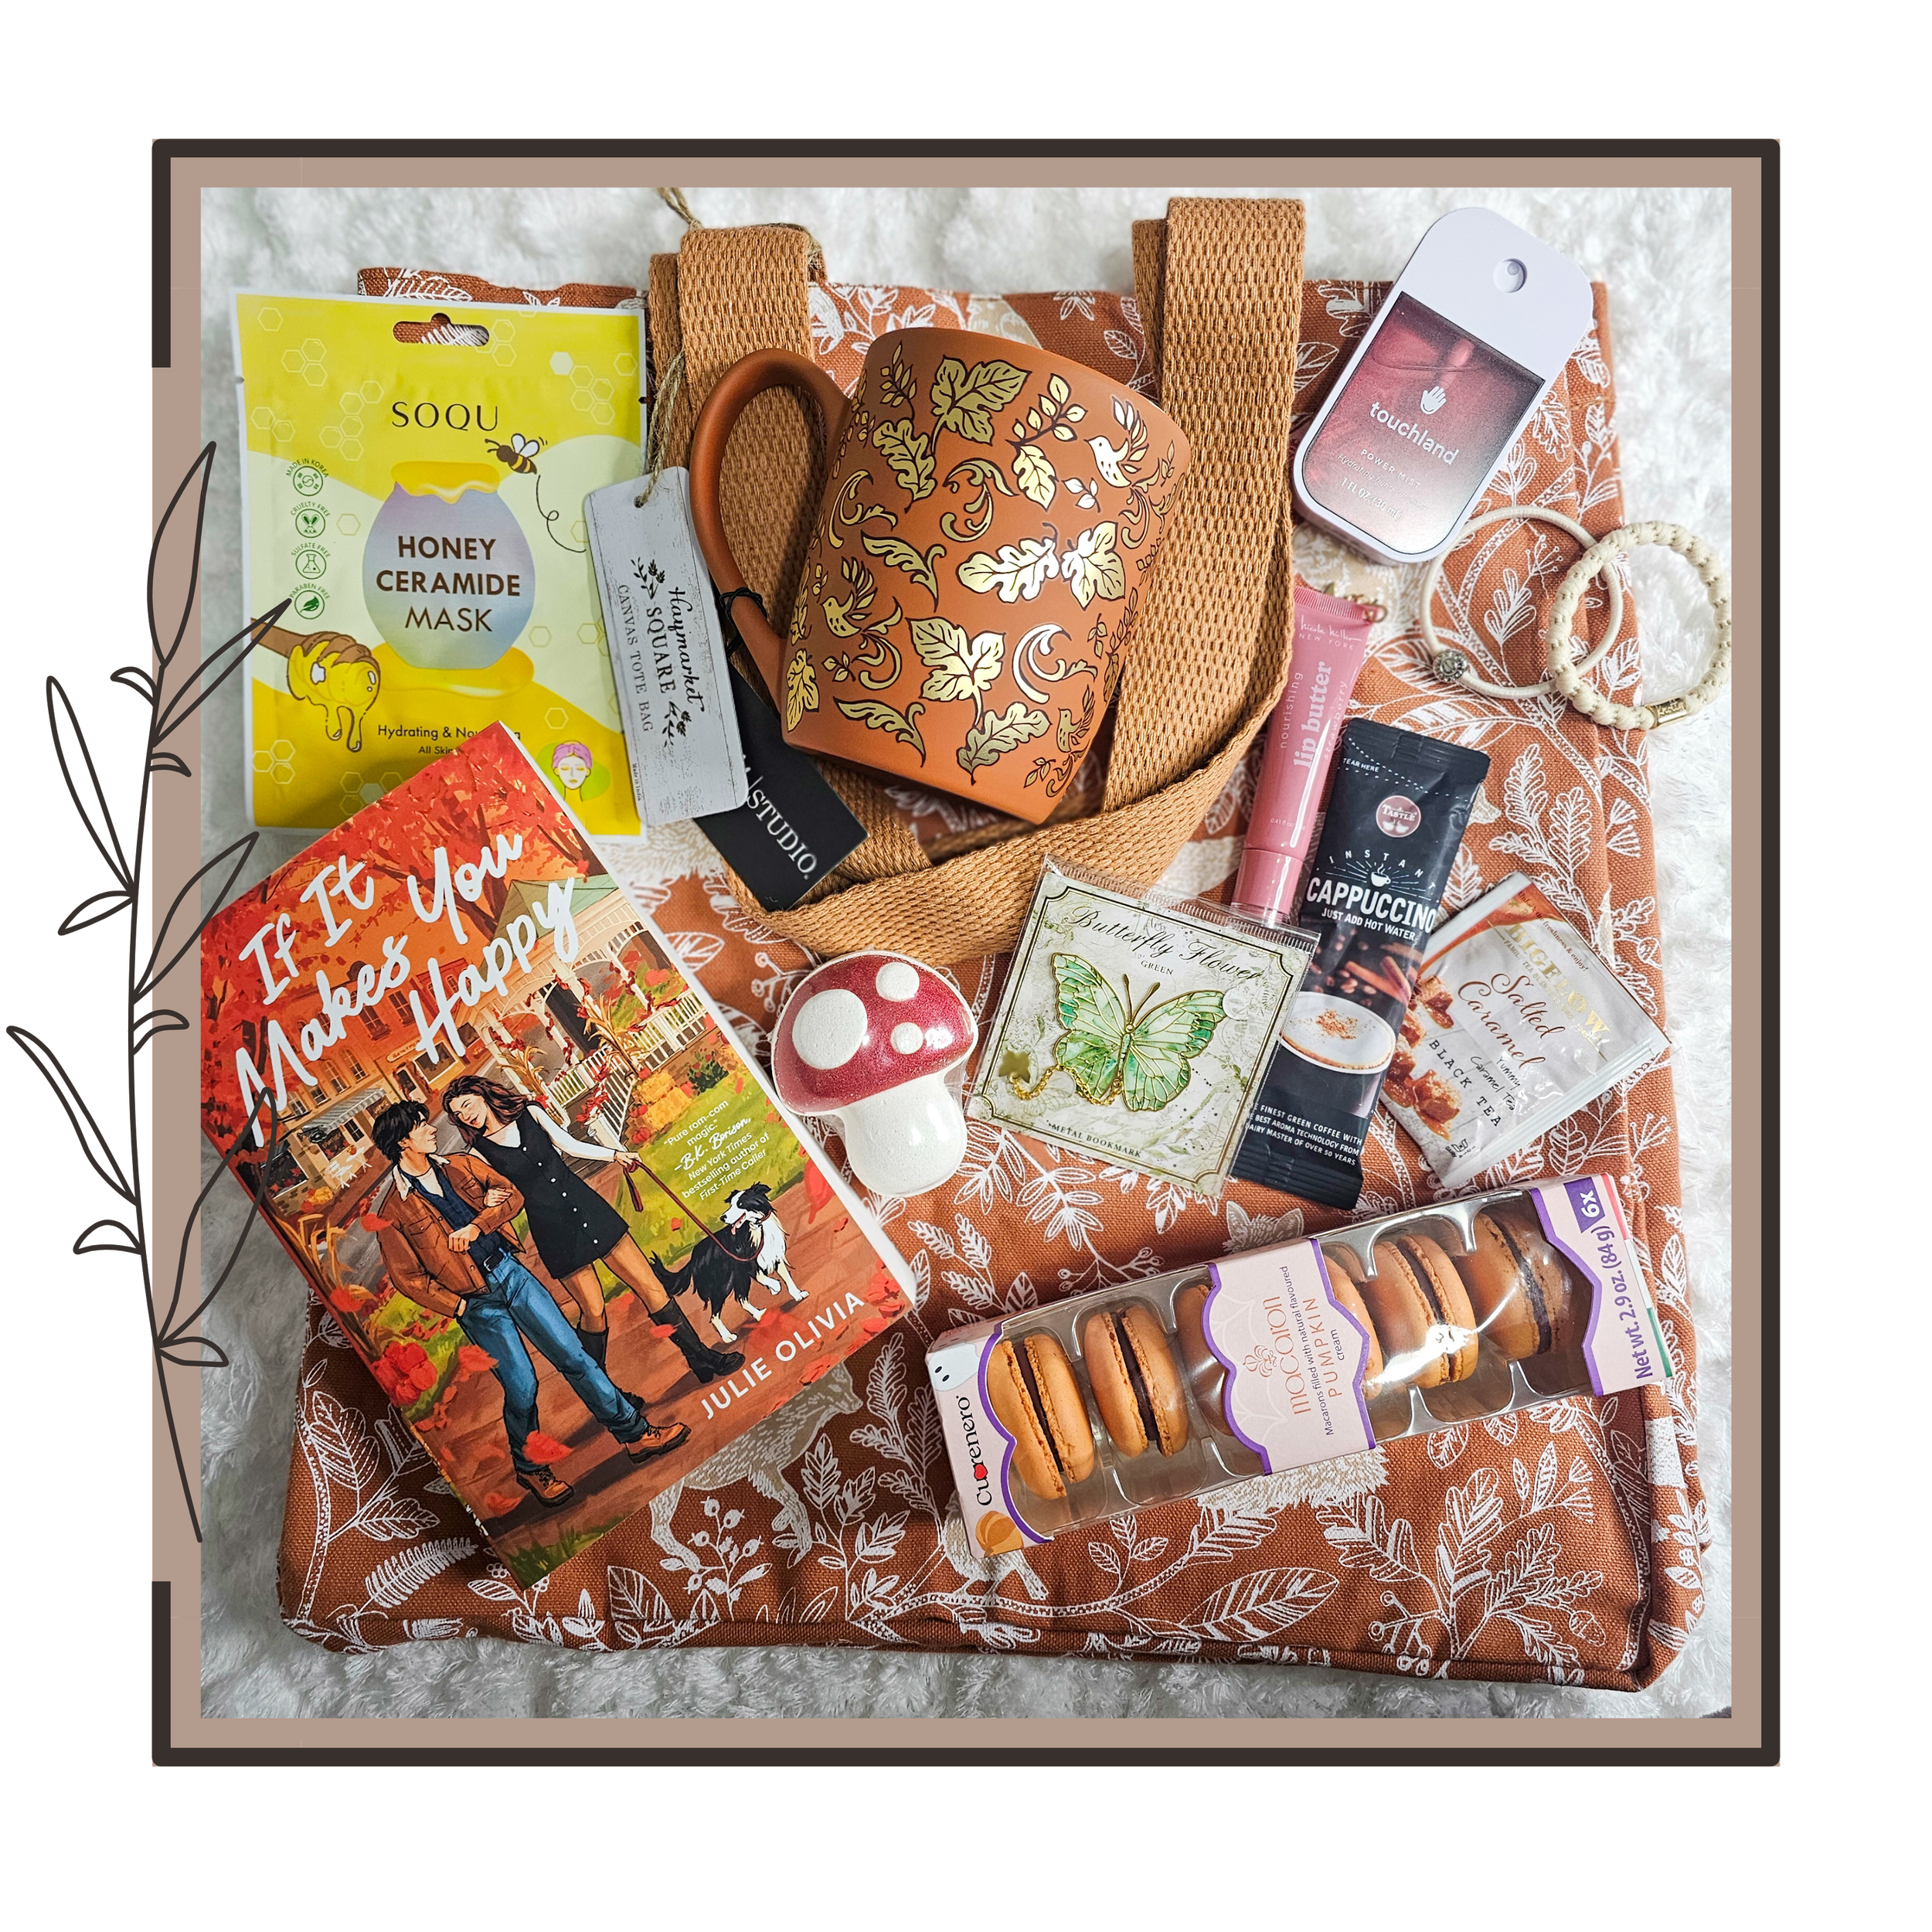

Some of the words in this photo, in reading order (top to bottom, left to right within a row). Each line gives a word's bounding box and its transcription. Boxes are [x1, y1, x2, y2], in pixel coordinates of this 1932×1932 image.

[392, 401, 498, 431] SOQU
[1369, 402, 1459, 464] touchland
[286, 459, 301, 477] MADE
[311, 458, 329, 478] KOREA
[1337, 454, 1375, 481] Hydrating
[1361, 448, 1395, 474] POWER
[1397, 471, 1421, 489] MIST
[290, 502, 316, 515] CRUELTY
[317, 503, 331, 518] FREE
[1341, 478, 1347, 487] 1
[1347, 481, 1358, 493] FL
[1371, 496, 1388, 511] (30
[291, 543, 316, 556] SULFATE
[317, 544, 332, 558] FREE
[397, 536, 496, 560] HONEY
[289, 583, 317, 598] PARABEN
[317, 586, 331, 600] FREE
[376, 570, 521, 597] CERAMIDE
[404, 605, 493, 632] MASK
[618, 584, 638, 646] CANVAS
[631, 651, 647, 694] TOTE
[639, 701, 654, 732] BAG
[647, 607, 676, 694] SQUARE
[668, 587, 705, 713] Haymarket
[1299, 633, 1321, 642] NEW
[1328, 638, 1353, 650] YORK
[1281, 672, 1304, 749] nourishing
[1301, 661, 1332, 733] butter
[378, 724, 438, 741] Hydrating
[443, 726, 452, 738] &
[1323, 681, 1348, 760] strawberry
[418, 746, 431, 754] All
[1293, 737, 1318, 769] lip
[1342, 758, 1360, 767] TEAR
[1360, 763, 1380, 773] HERE
[1328, 849, 1436, 889] INSTANT
[1306, 877, 1437, 934] CAPPUCCINO
[239, 913, 300, 1005] If
[301, 855, 376, 947] It
[1321, 908, 1344, 920] JUST
[1345, 913, 1363, 926] ADD
[1364, 918, 1383, 931] HOT
[1384, 923, 1416, 941] WATER
[1060, 906, 1175, 957] Butterfly
[1179, 940, 1265, 980] Flower
[408, 876, 579, 1065] Happy
[1141, 960, 1175, 976] GREEN
[1505, 923, 1610, 1033] BIGELOW
[1522, 960, 1534, 974] TEA
[234, 934, 411, 1148] Makes
[406, 833, 523, 945] You
[1491, 973, 1566, 1039] Salted
[1458, 981, 1546, 1070] Caramel
[1428, 1039, 1472, 1088] BLACK
[1476, 1096, 1502, 1127] TEA
[1470, 1056, 1505, 1093] Caramel
[1502, 1092, 1515, 1111] Tea
[1496, 1056, 1521, 1091] Yummy
[688, 1100, 729, 1131] rom-com
[1260, 1104, 1286, 1118] FINEST
[1287, 1114, 1312, 1129] GREEN
[1313, 1124, 1342, 1139] COFFEE
[1342, 1133, 1363, 1146] WITH
[708, 1117, 752, 1151] Borison,
[1051, 1124, 1083, 1139] METAL
[1086, 1134, 1142, 1158] BOOKMARK
[1255, 1114, 1272, 1125] BEST
[1271, 1120, 1295, 1134] AROMA
[1296, 1128, 1340, 1149] TECHNOLOGY
[1339, 1144, 1360, 1157] FROM
[1266, 1128, 1293, 1145] MASTER
[1304, 1141, 1323, 1154] OVER
[1324, 1149, 1333, 1158] 50
[1334, 1152, 1356, 1166] YEARS
[681, 1162, 730, 1199] bestselling
[730, 1140, 759, 1165] author
[760, 1131, 770, 1144] of
[688, 1164, 707, 1181] New
[706, 1150, 726, 1167] York
[725, 1132, 753, 1154] Times
[699, 1168, 741, 1201] First-Time
[741, 1148, 767, 1171] Caller
[1580, 1189, 1600, 1219] 6x
[1590, 1226, 1615, 1241] g)
[1597, 1243, 1621, 1269] (84
[1279, 1265, 1299, 1310] flavoured
[1611, 1270, 1628, 1293] oz.
[1614, 1295, 1636, 1321] 2.9
[1291, 1310, 1309, 1345] natural
[1330, 1328, 1345, 1361] cream
[1624, 1320, 1644, 1349] wt.
[701, 1357, 772, 1420] JULIE
[775, 1291, 866, 1362] OLIVIA
[1262, 1296, 1311, 1415] macaron
[1303, 1298, 1342, 1399] PUMPKIN
[1304, 1346, 1315, 1366] with
[1632, 1349, 1653, 1379] Net
[1307, 1367, 1320, 1390] filled
[1315, 1391, 1334, 1436] Macarons
